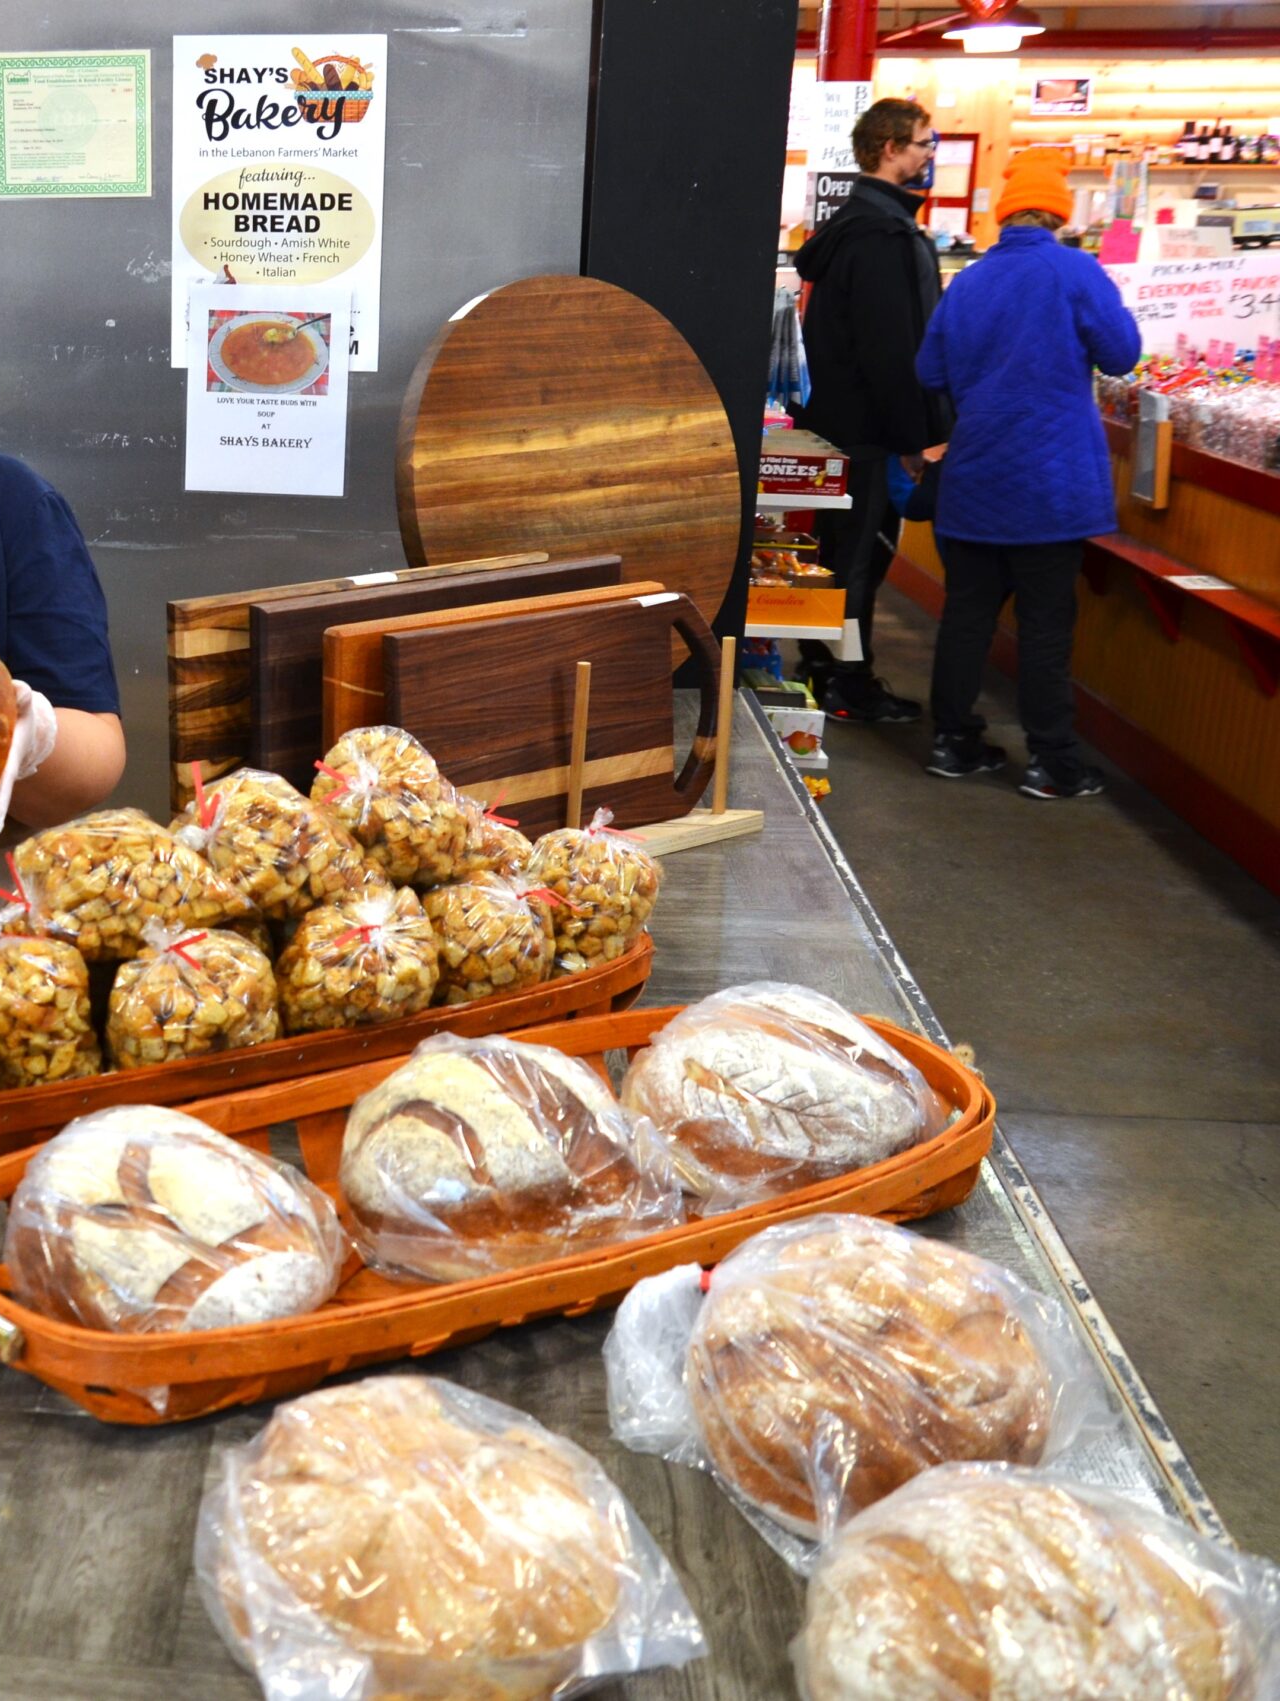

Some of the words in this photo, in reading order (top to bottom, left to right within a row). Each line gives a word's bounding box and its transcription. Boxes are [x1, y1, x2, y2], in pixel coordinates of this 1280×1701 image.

[203, 67, 289, 84] SHAY'S
[196, 88, 345, 142] Bakery
[199, 148, 210, 158] in
[211, 148, 228, 158] the
[230, 148, 276, 158] Lebanon
[322, 148, 359, 158] Market
[203, 192, 353, 211] HOMEMADE
[234, 214, 321, 233] BREAD
[210, 237, 272, 250] Sourdough
[280, 237, 316, 249] Amish
[317, 237, 351, 249] White
[220, 252, 256, 264] Honey
[258, 252, 294, 263] Wheat
[302, 252, 340, 263] French
[262, 267, 297, 278] Italian
[217, 397, 235, 405] LOVE
[236, 397, 255, 406] YOUR
[256, 398, 279, 406] TASTE
[280, 399, 299, 407] BUDS
[300, 399, 318, 407] WITH
[261, 437, 313, 449] BAKERY
[759, 463, 818, 476] ONEES
